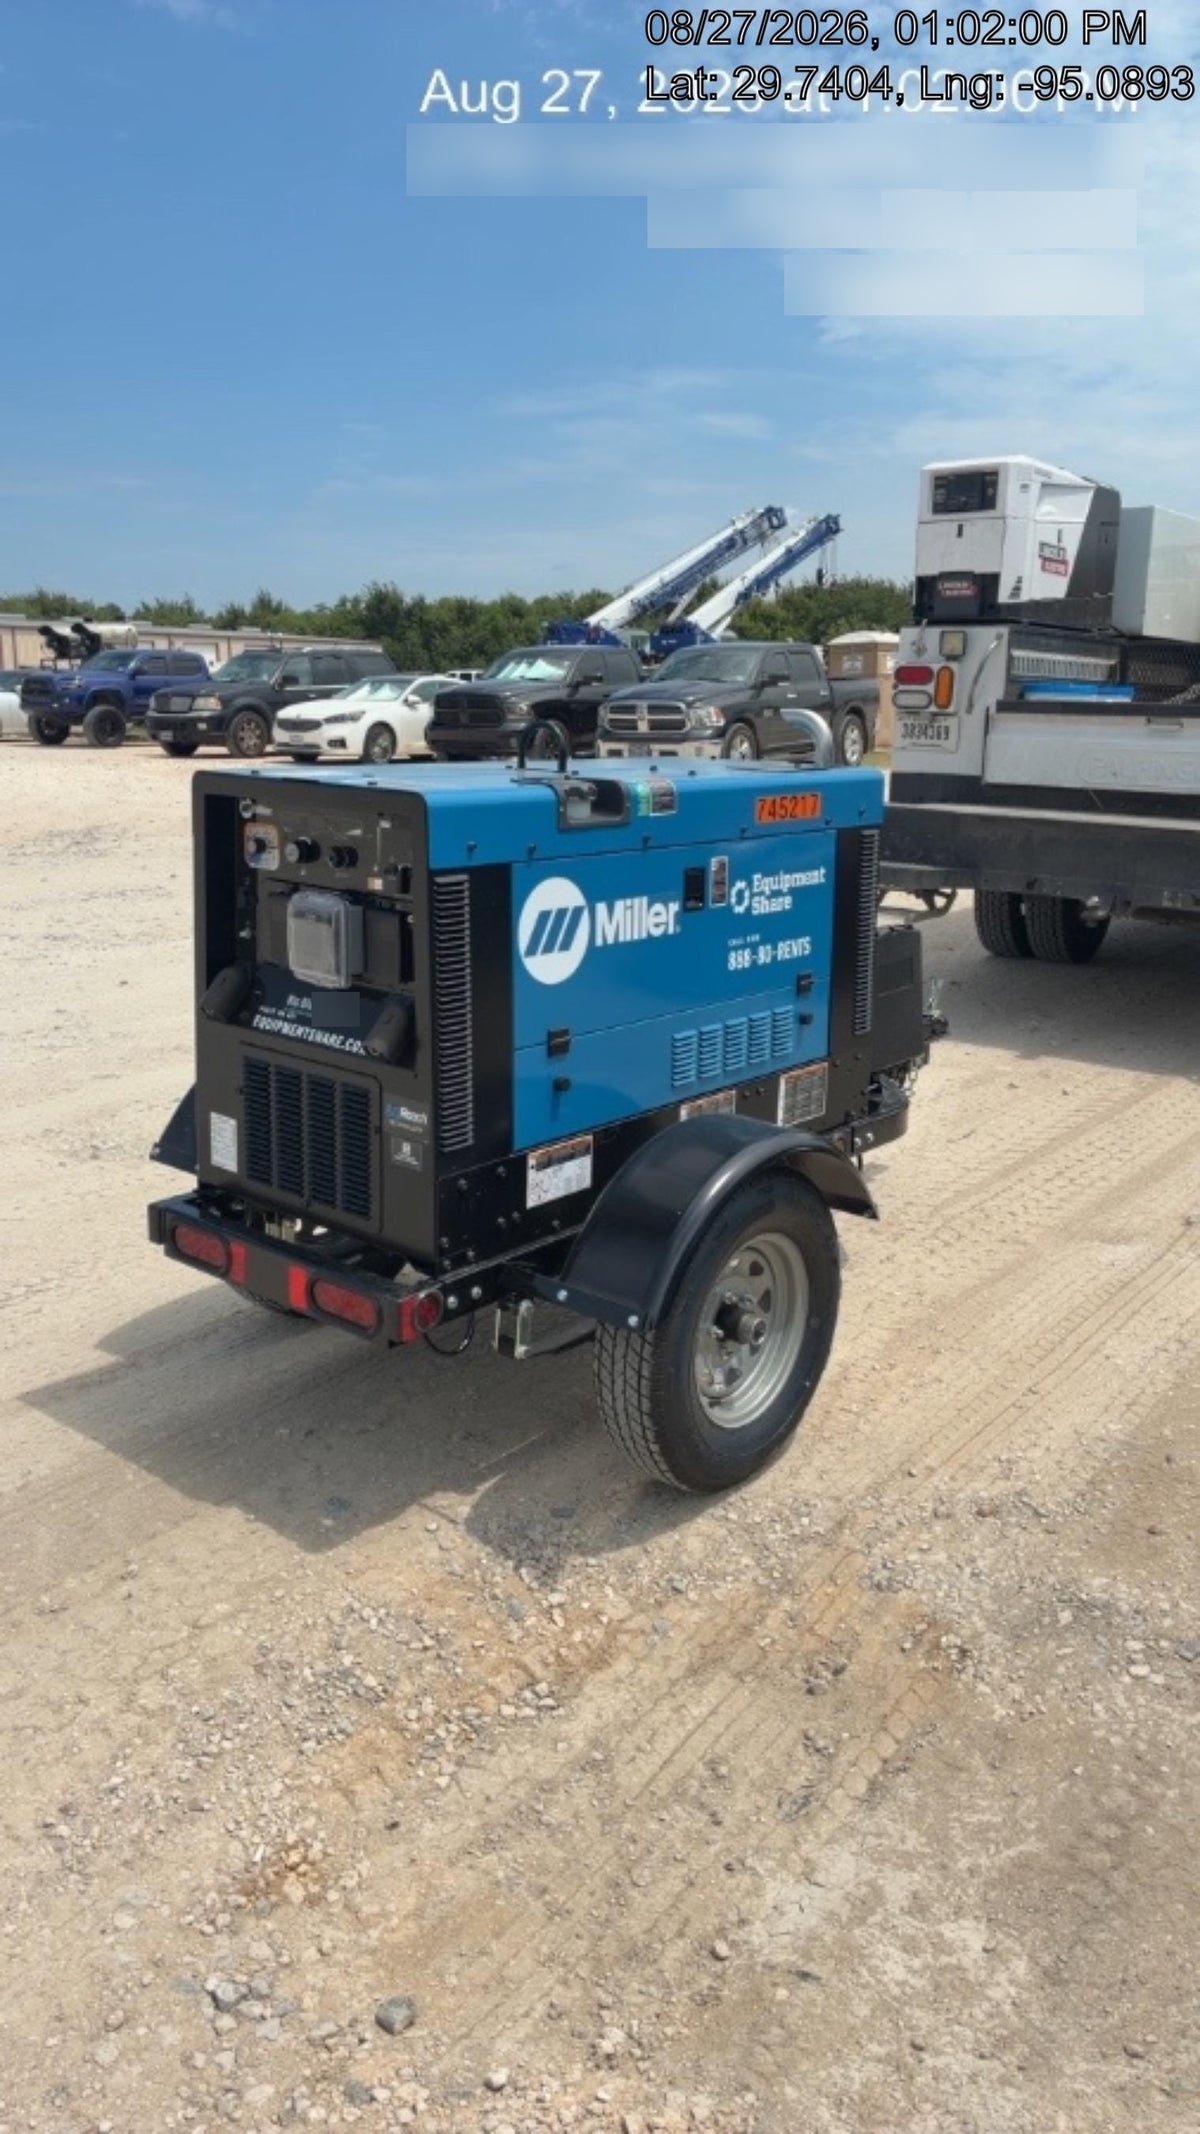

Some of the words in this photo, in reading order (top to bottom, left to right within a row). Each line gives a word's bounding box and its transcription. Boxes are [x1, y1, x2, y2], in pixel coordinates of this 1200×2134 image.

[758, 794, 819, 822] 745217
[752, 866, 826, 895] Equipment
[751, 895, 793, 915] Share
[594, 896, 680, 947] Miller
